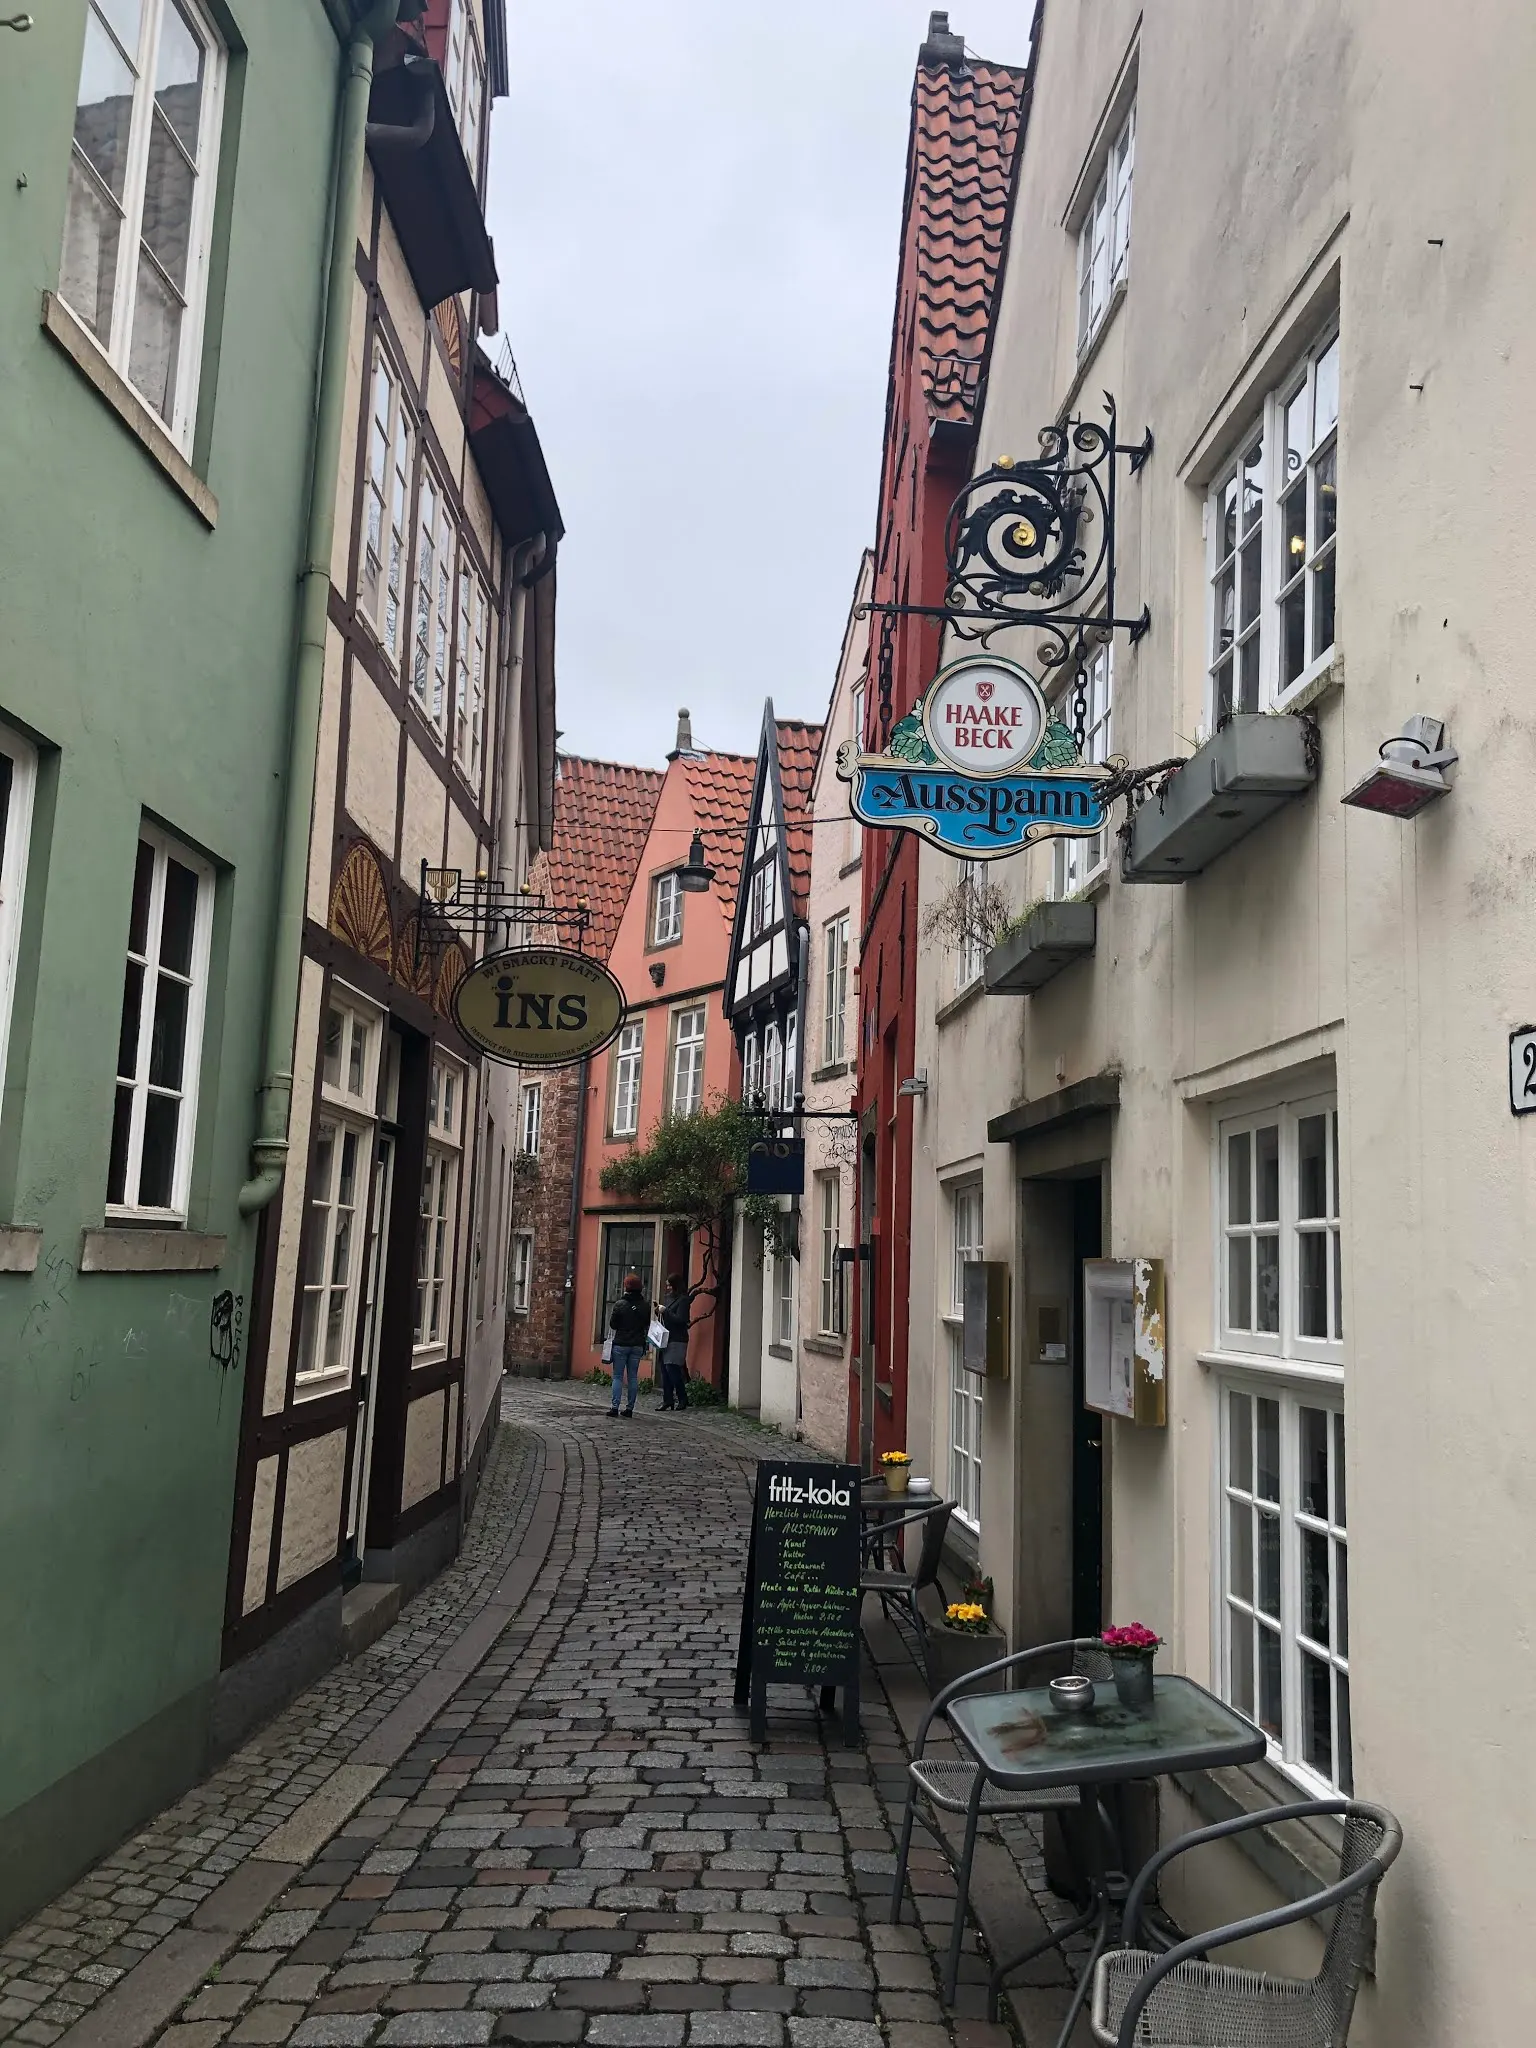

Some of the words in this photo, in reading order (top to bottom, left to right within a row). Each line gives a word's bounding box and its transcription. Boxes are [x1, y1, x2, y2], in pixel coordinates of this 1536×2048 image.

[945, 704, 1023, 727] HAAKE
[954, 727, 1014, 749] BECK
[872, 774, 1090, 841] Ausspann
[481, 964, 501, 980] WI
[503, 955, 558, 972] SNACKT
[560, 958, 601, 984] PLATT
[470, 1025, 498, 1050] INSTITUT
[497, 1045, 512, 1055] FÜR
[576, 1030, 606, 1051] SPRACHE
[764, 1506, 799, 1520] Herzlich
[803, 1508, 847, 1521] willkommen
[782, 1522, 839, 1537] AUSSPANN
[783, 1538, 807, 1548] Kunst
[782, 1550, 806, 1559] Kultur
[783, 1560, 826, 1571] Restaurant
[760, 1581, 782, 1592] Heute
[786, 1585, 799, 1593] aus
